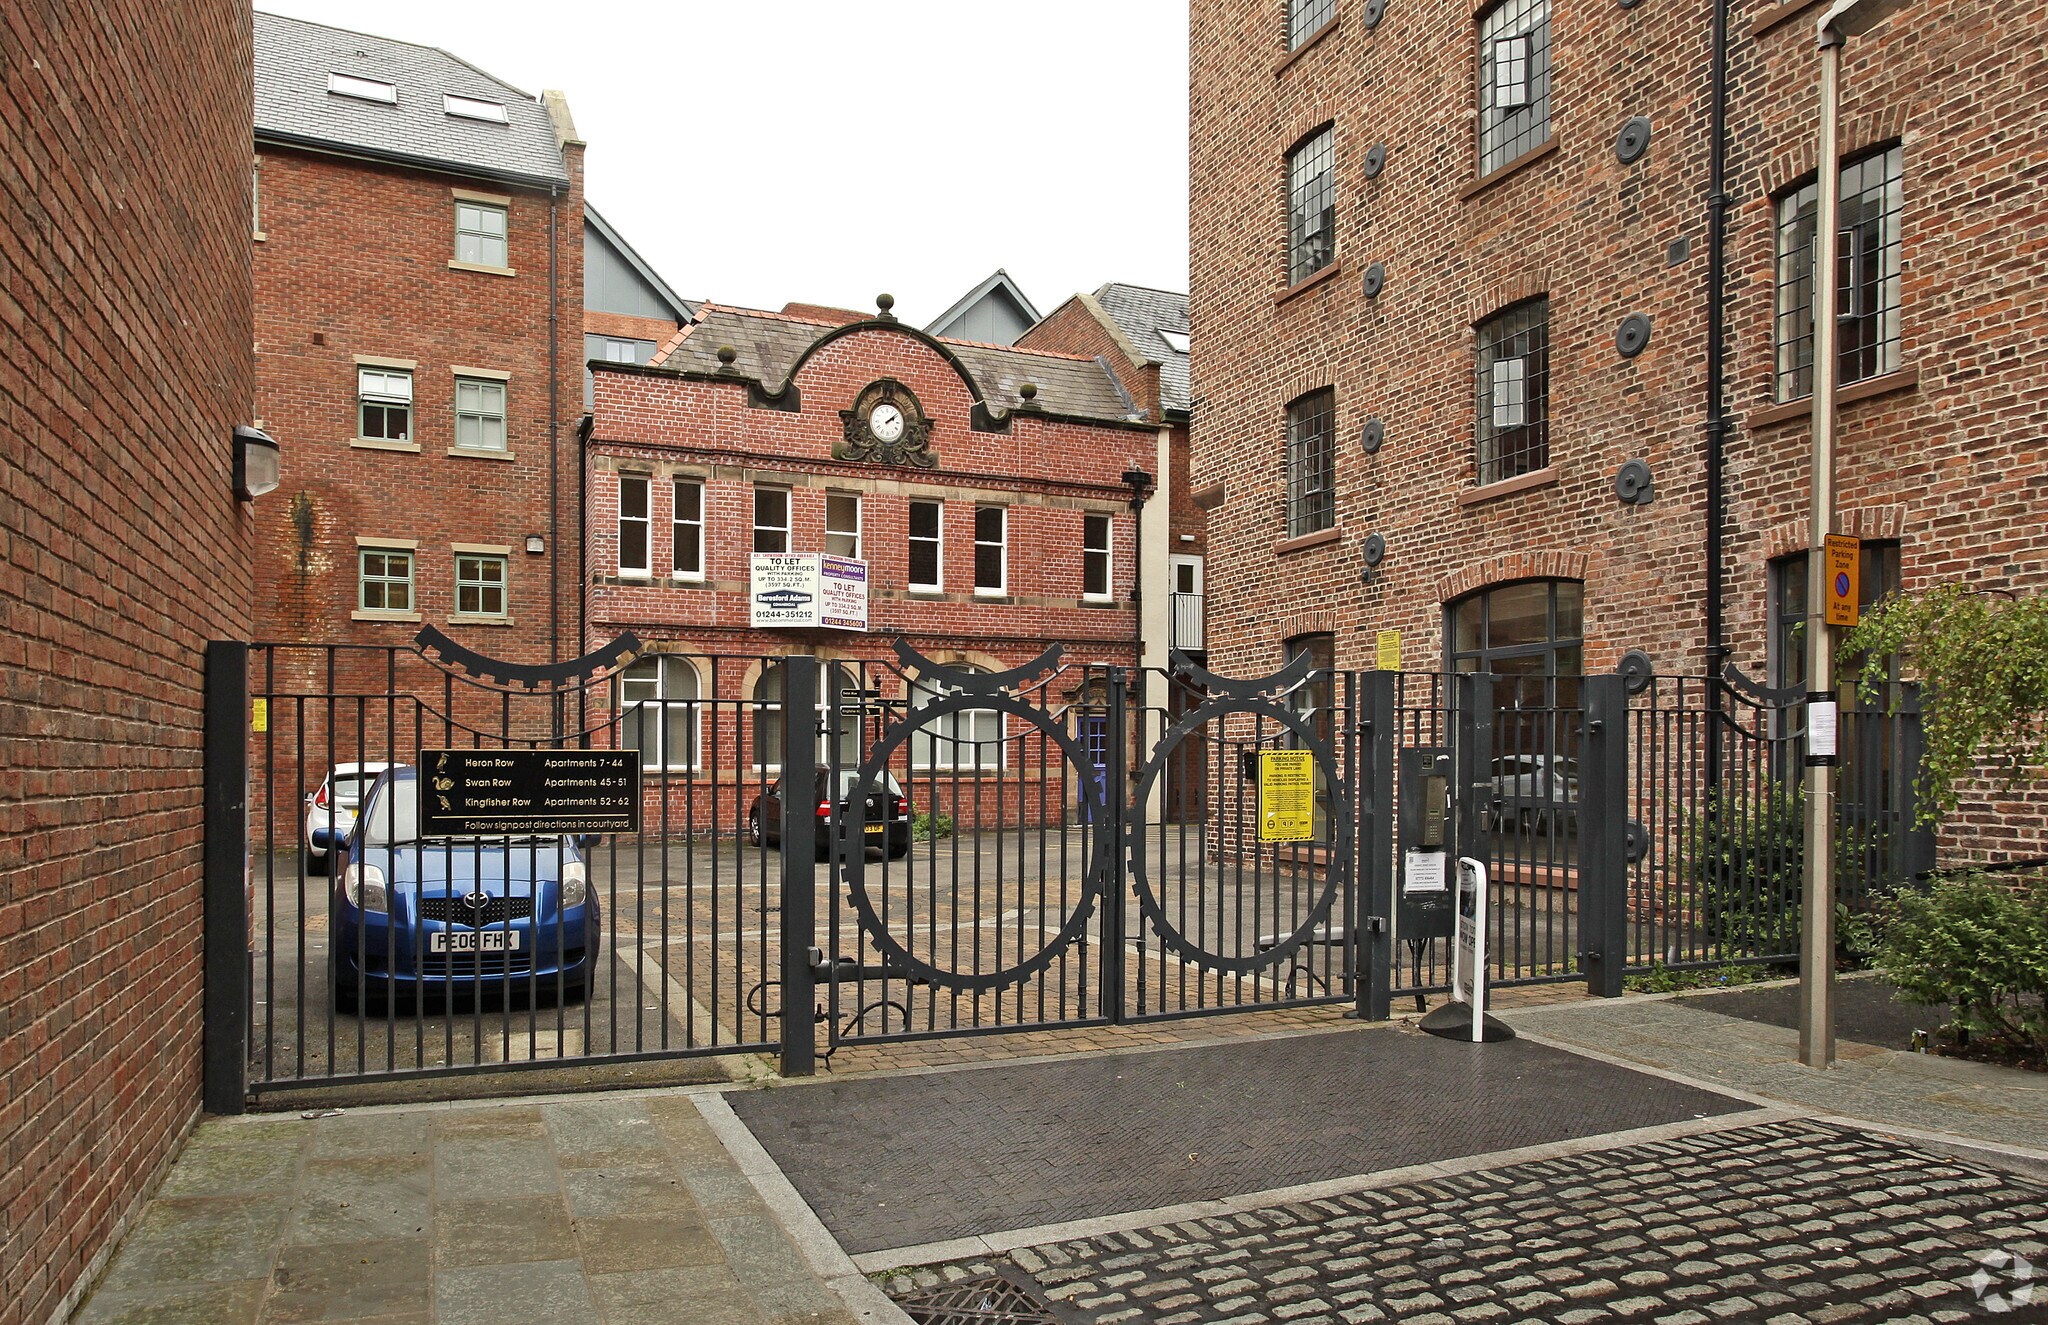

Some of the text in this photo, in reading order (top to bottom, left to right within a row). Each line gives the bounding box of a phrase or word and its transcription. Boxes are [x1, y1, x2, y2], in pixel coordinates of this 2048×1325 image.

[1828, 538, 1857, 549] Restricted
[1832, 549, 1853, 560] Parking
[823, 560, 864, 574] kenneymoore
[1836, 560, 1849, 569] Zone
[465, 759, 493, 767] Heron
[495, 759, 514, 767] Row
[545, 759, 596, 769] Apartments
[466, 779, 490, 787] Swan
[493, 779, 512, 787] Row
[545, 778, 596, 788] Apartments
[600, 778, 611, 786] 45
[618, 778, 627, 786] 51
[465, 798, 510, 808] Kingfisher
[513, 798, 531, 806] Row
[545, 797, 596, 808] Apartments
[600, 798, 611, 806] 52
[618, 798, 629, 806] 62
[465, 820, 629, 831] Follow signpost directions in courtyard
